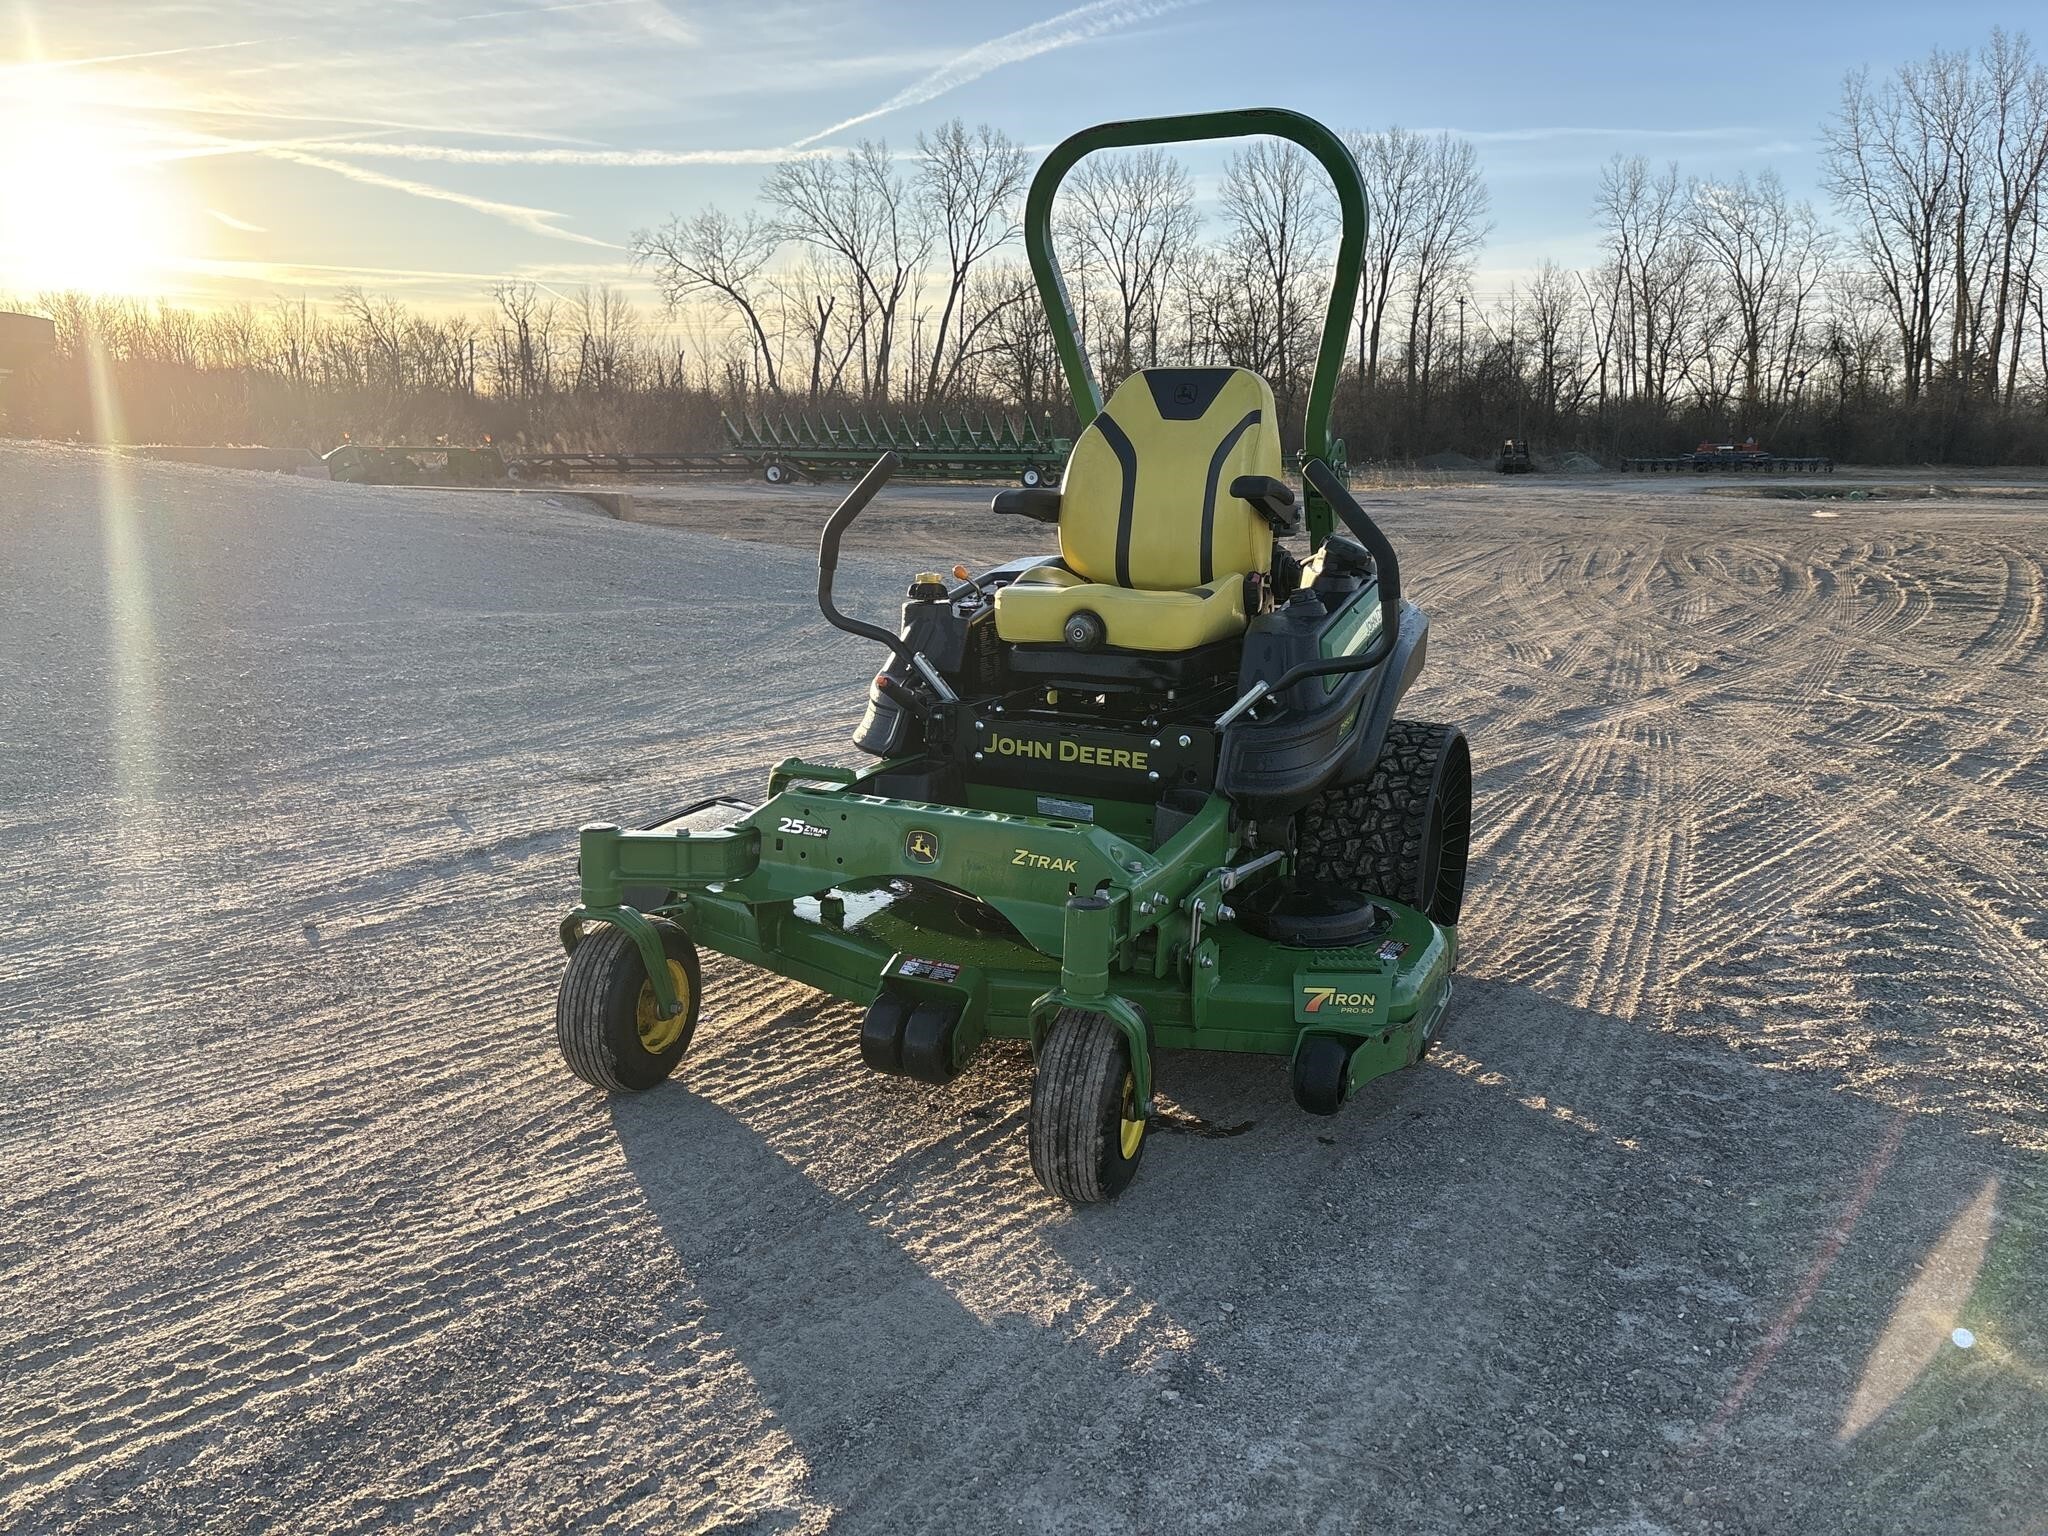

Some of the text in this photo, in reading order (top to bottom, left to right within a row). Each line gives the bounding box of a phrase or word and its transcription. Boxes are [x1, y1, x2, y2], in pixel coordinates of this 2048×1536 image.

[984, 733, 1148, 770] JOHN DEERE
[777, 817, 805, 834] 25
[803, 825, 829, 835] ZTRAK
[1011, 848, 1078, 873] ZTRAK
[1303, 987, 1376, 1012] 7 IRON
